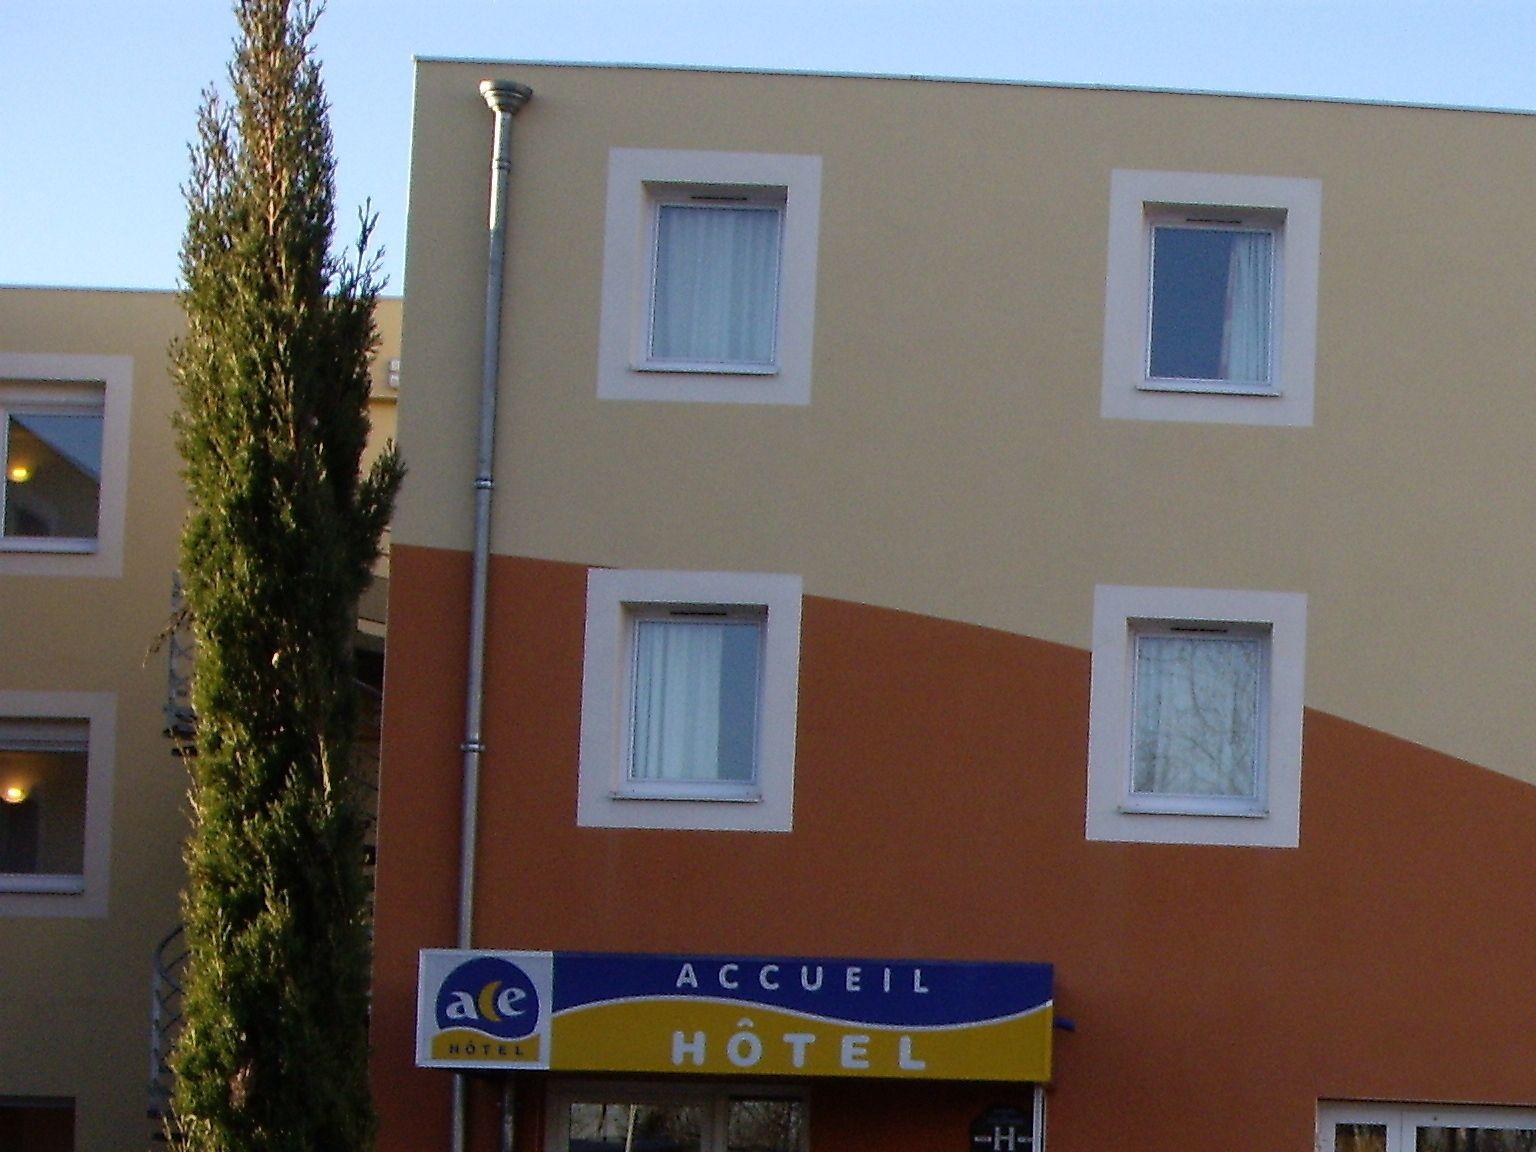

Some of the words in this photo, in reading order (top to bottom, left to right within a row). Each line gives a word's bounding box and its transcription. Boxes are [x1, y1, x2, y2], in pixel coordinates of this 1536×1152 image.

[676, 963, 929, 994] ACCUEIL
[445, 980, 527, 1022] ace
[449, 1041, 524, 1056] HÔTEL
[671, 1018, 926, 1070] HÔTEL
